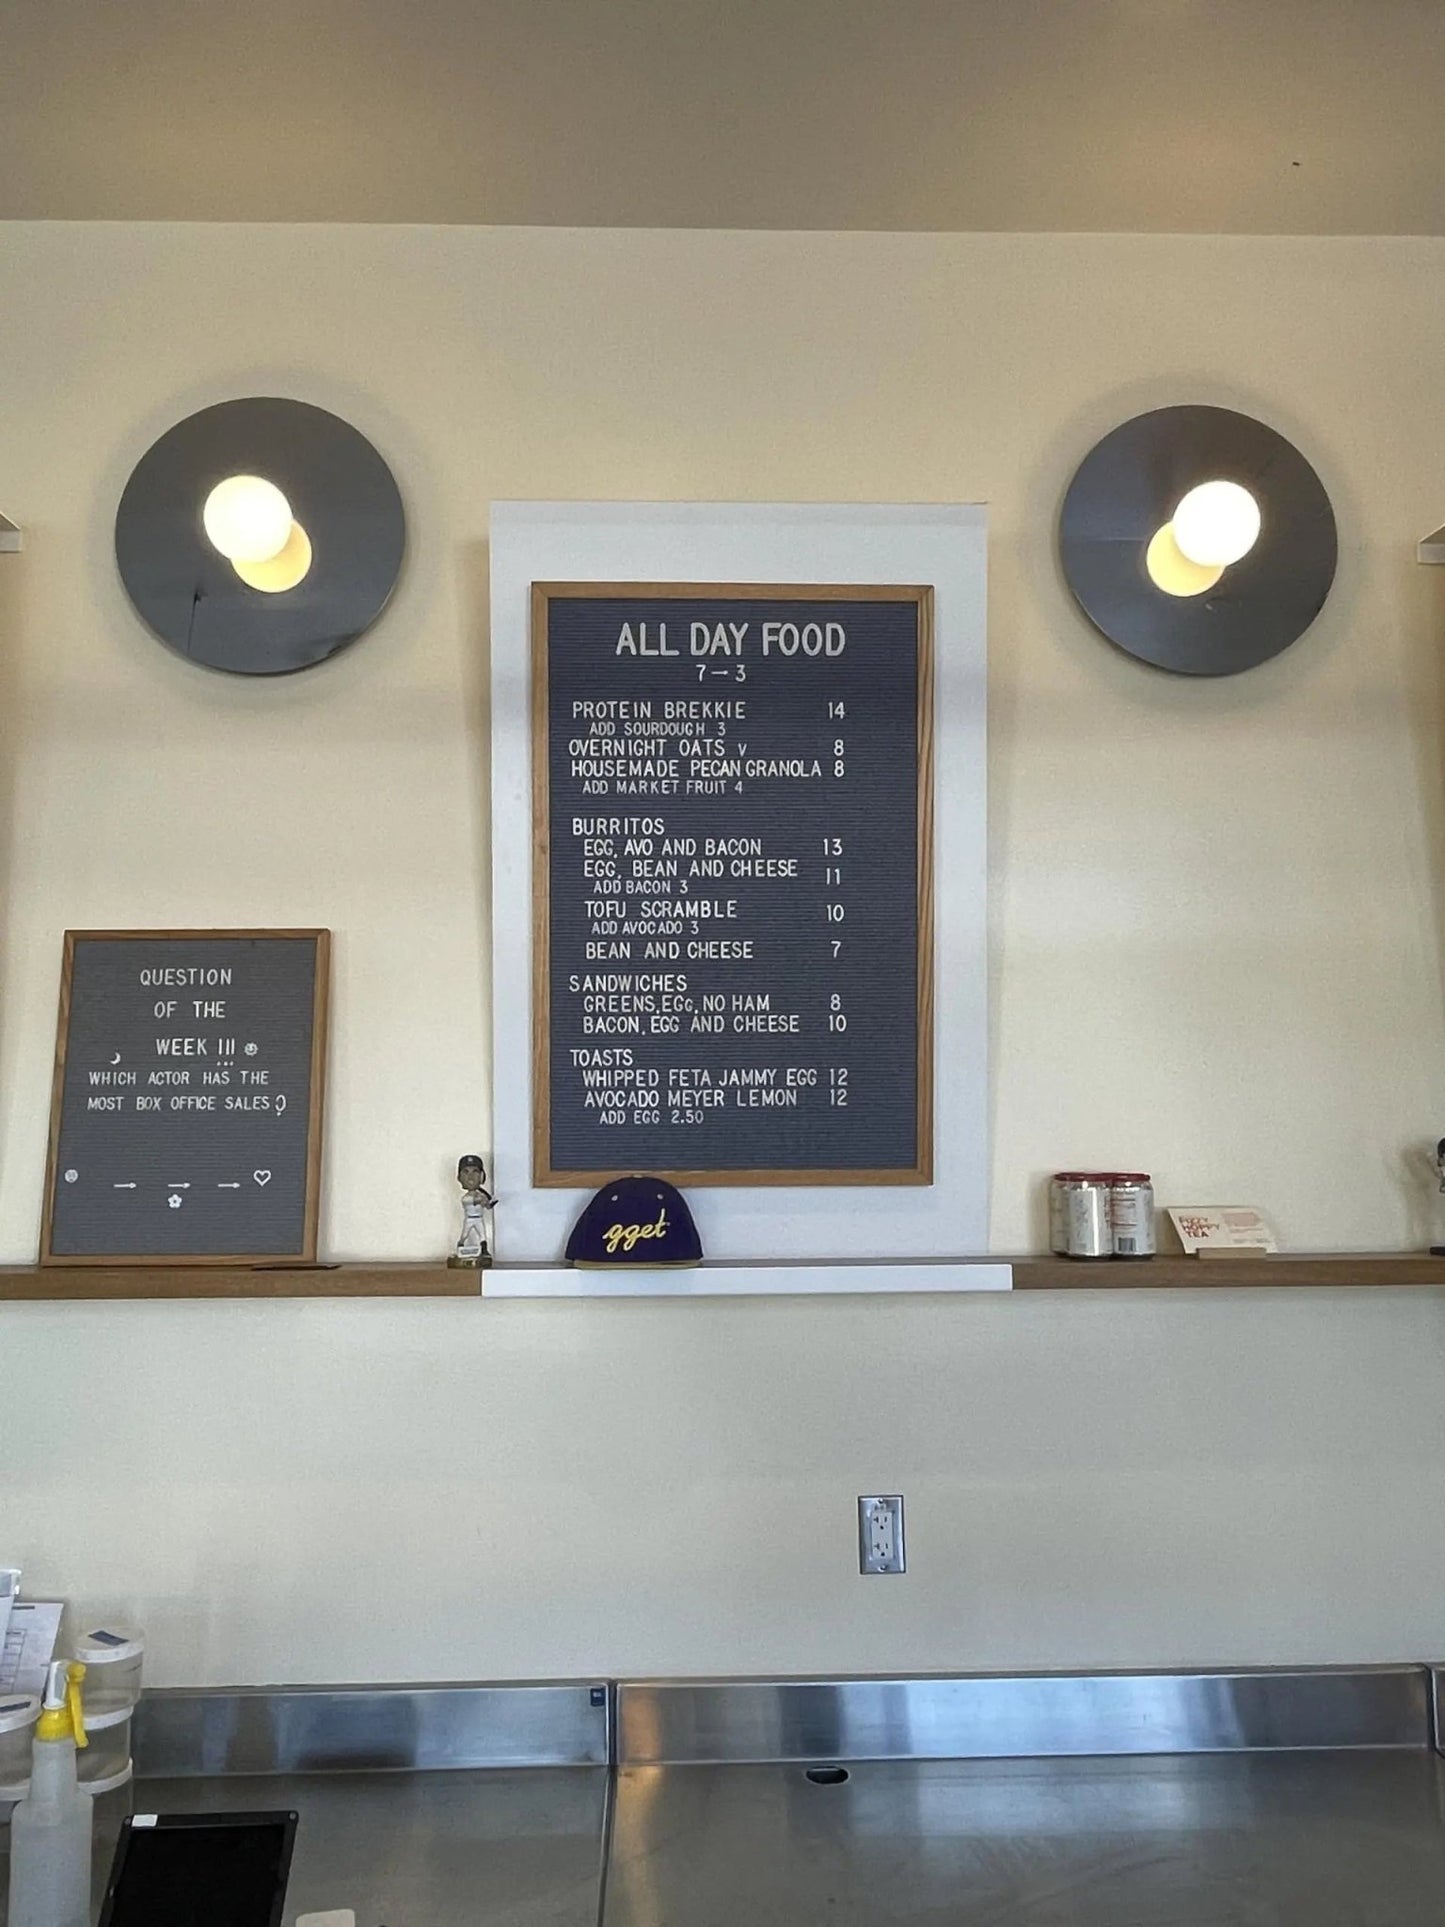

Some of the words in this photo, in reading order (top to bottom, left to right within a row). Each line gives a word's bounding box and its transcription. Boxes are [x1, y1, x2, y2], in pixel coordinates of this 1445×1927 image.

[616, 622, 679, 656] ALL
[690, 622, 749, 656] DAY
[761, 622, 846, 656] FOOD
[696, 664, 706, 682] 7
[735, 664, 746, 682] 3
[572, 701, 651, 719] PROTEIN
[664, 701, 746, 719] BREKKIE
[828, 702, 845, 719] 14
[589, 722, 616, 736] ADD
[624, 722, 706, 736] SOURDOUGH
[717, 722, 726, 736] 3
[568, 739, 667, 756] OVERNIGHT
[678, 739, 726, 756] OATS
[834, 739, 844, 756] 8
[571, 760, 679, 778] HOUSEMADE
[690, 760, 741, 778] PECAN
[745, 760, 822, 778] GRANOLA
[834, 760, 844, 778] 8
[582, 781, 609, 794] ADD
[616, 780, 679, 794] MARKET
[686, 780, 726, 794] FRUIT
[734, 780, 743, 794] 4
[572, 818, 665, 835] BURRITOS
[624, 839, 653, 856] AVO
[661, 839, 696, 856] AND
[705, 839, 761, 856] BACON
[822, 839, 843, 856] 13
[632, 860, 678, 878] BEAN
[689, 860, 724, 878] AND
[731, 859, 798, 878] CHEESE
[826, 868, 841, 885] 11
[594, 881, 621, 894] ADD
[626, 880, 671, 894] BACON
[679, 880, 688, 894] 3
[584, 901, 626, 918] TOFU
[641, 901, 738, 918] SCRAMBLE
[827, 905, 844, 922] 10
[591, 921, 618, 935] ADD
[622, 921, 683, 935] AVOCADO
[691, 921, 699, 935] 3
[586, 942, 630, 959] BEAN
[644, 942, 679, 959] AND
[687, 941, 754, 959] CHEESE
[831, 941, 841, 958] 7
[140, 968, 233, 986] QUESTION
[569, 974, 688, 992] SANDWICHES
[154, 1001, 178, 1018] OF
[193, 1001, 226, 1018] THE
[703, 995, 726, 1012] NO
[732, 995, 770, 1012] HAM
[831, 994, 841, 1011] 8
[651, 1015, 679, 1033] EGG
[691, 1015, 724, 1032] AND
[733, 1015, 800, 1032] CHEESE
[828, 1014, 847, 1032] 10
[156, 1038, 208, 1055] WEEK
[569, 1049, 633, 1066] TOASTS
[89, 1071, 137, 1085] WHICH
[147, 1071, 190, 1085] ACTOR
[203, 1071, 230, 1084] HAS
[240, 1070, 270, 1084] THE
[582, 1070, 659, 1087] WHIPPED
[669, 1070, 711, 1086] FETA
[719, 1069, 778, 1086] JAMMY
[786, 1069, 817, 1086] EGG
[829, 1069, 849, 1086] 12
[87, 1096, 125, 1110] MOST
[136, 1096, 162, 1111] BOX
[170, 1096, 216, 1111] OFFICE
[584, 1090, 660, 1108] AVOCADO
[668, 1090, 725, 1107] MEYER
[736, 1089, 798, 1106] LEMON
[830, 1089, 849, 1106] 12
[599, 1111, 626, 1124] ADD
[634, 1111, 660, 1124] EGG
[671, 1110, 704, 1124] 2.50
[602, 1208, 667, 1253] gget
